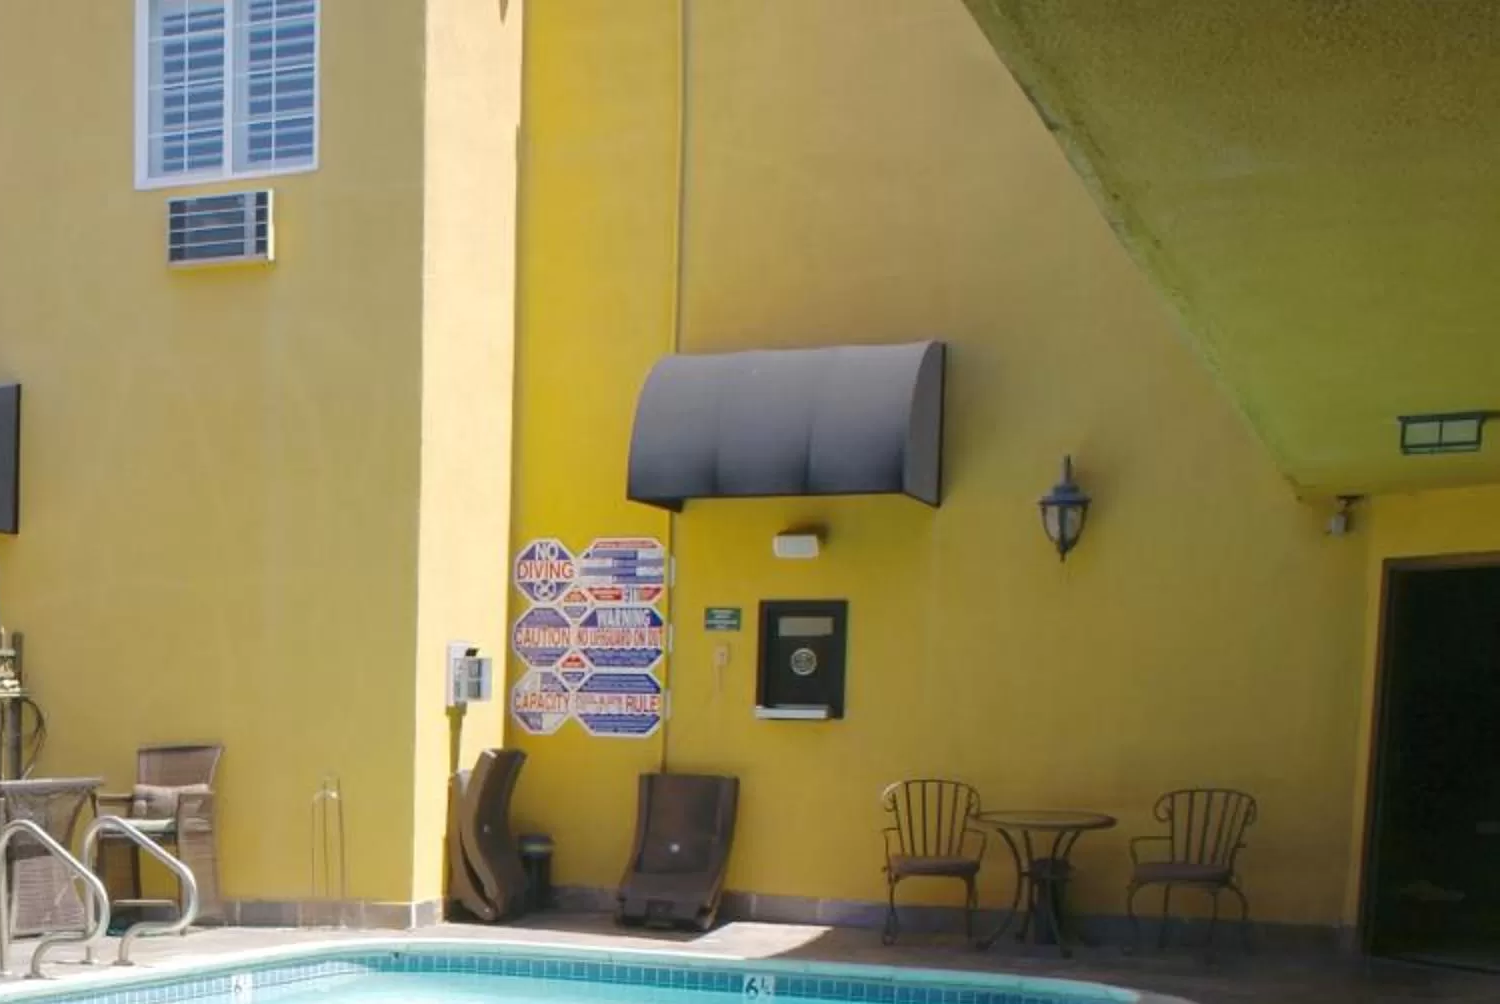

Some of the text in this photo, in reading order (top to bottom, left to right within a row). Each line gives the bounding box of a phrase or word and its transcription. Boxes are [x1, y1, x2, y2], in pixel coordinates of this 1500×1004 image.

[535, 543, 558, 560] NO
[516, 561, 575, 579] DIVING
[596, 607, 651, 628] WARNING
[513, 627, 570, 647] CAUTION
[514, 691, 569, 710] CAPACITY
